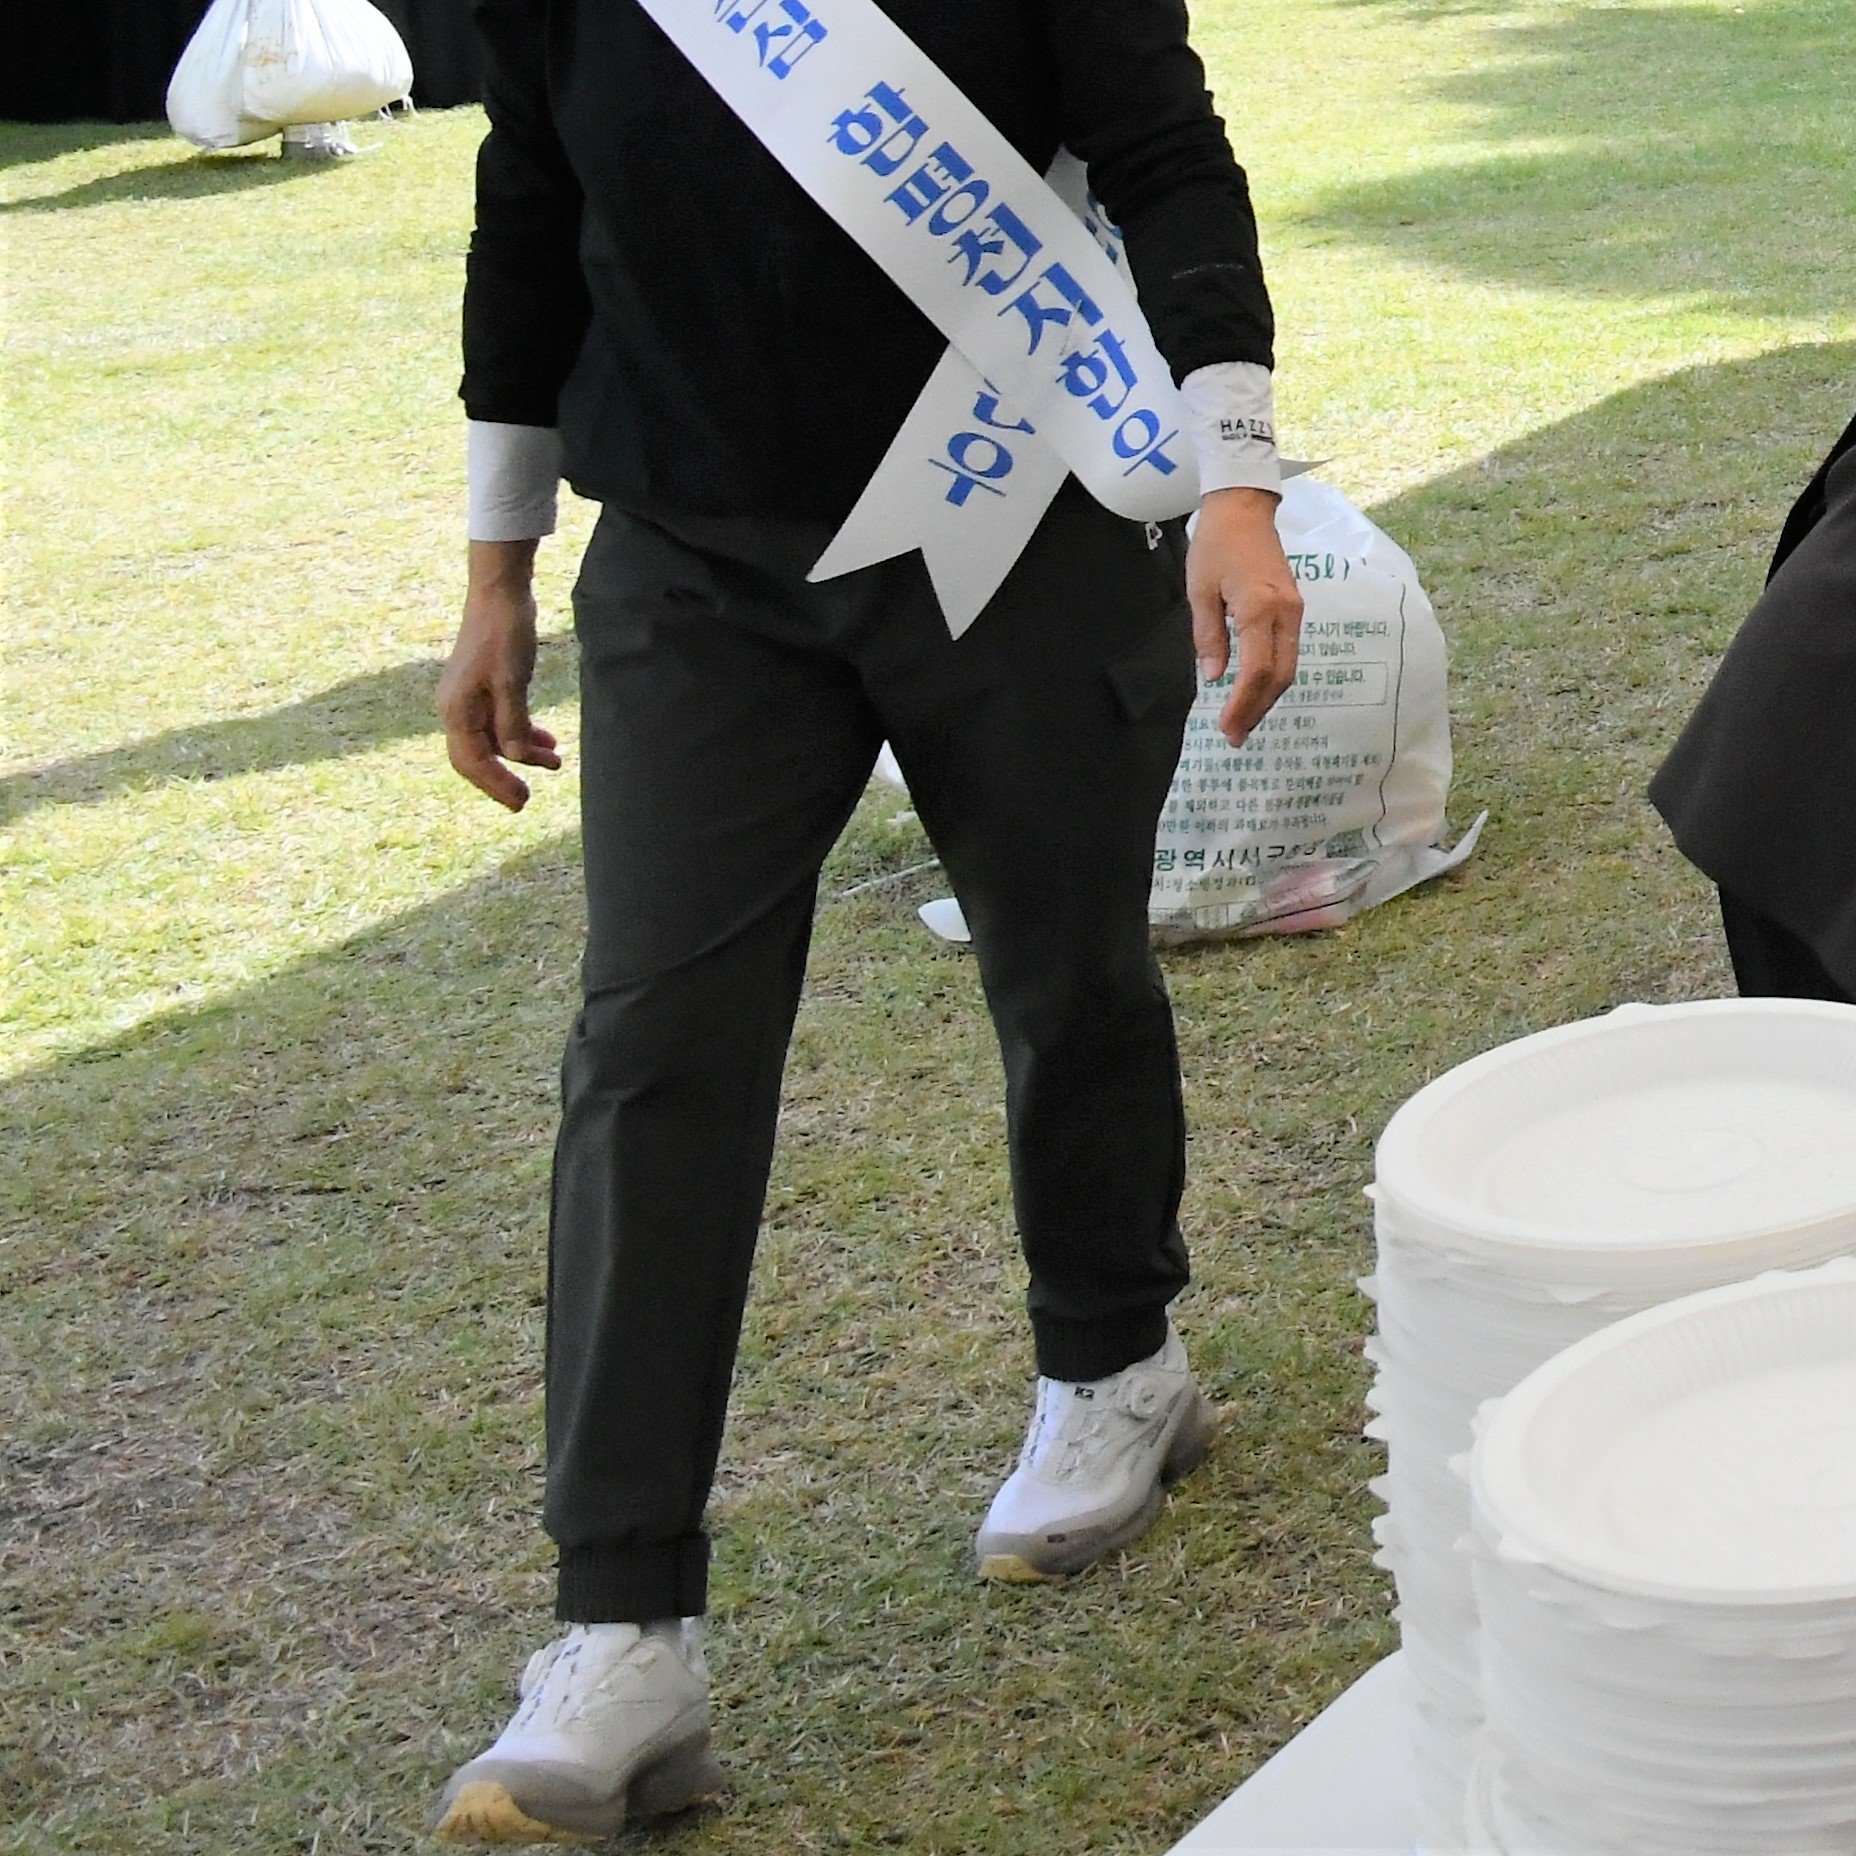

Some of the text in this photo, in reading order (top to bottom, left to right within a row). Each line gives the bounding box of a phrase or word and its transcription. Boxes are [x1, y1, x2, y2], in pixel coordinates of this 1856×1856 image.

[826, 81, 1180, 477] 함평천지한우
[1304, 621, 1390, 638] 주시기 바랍니다.
[1312, 672, 1324, 685] 수
